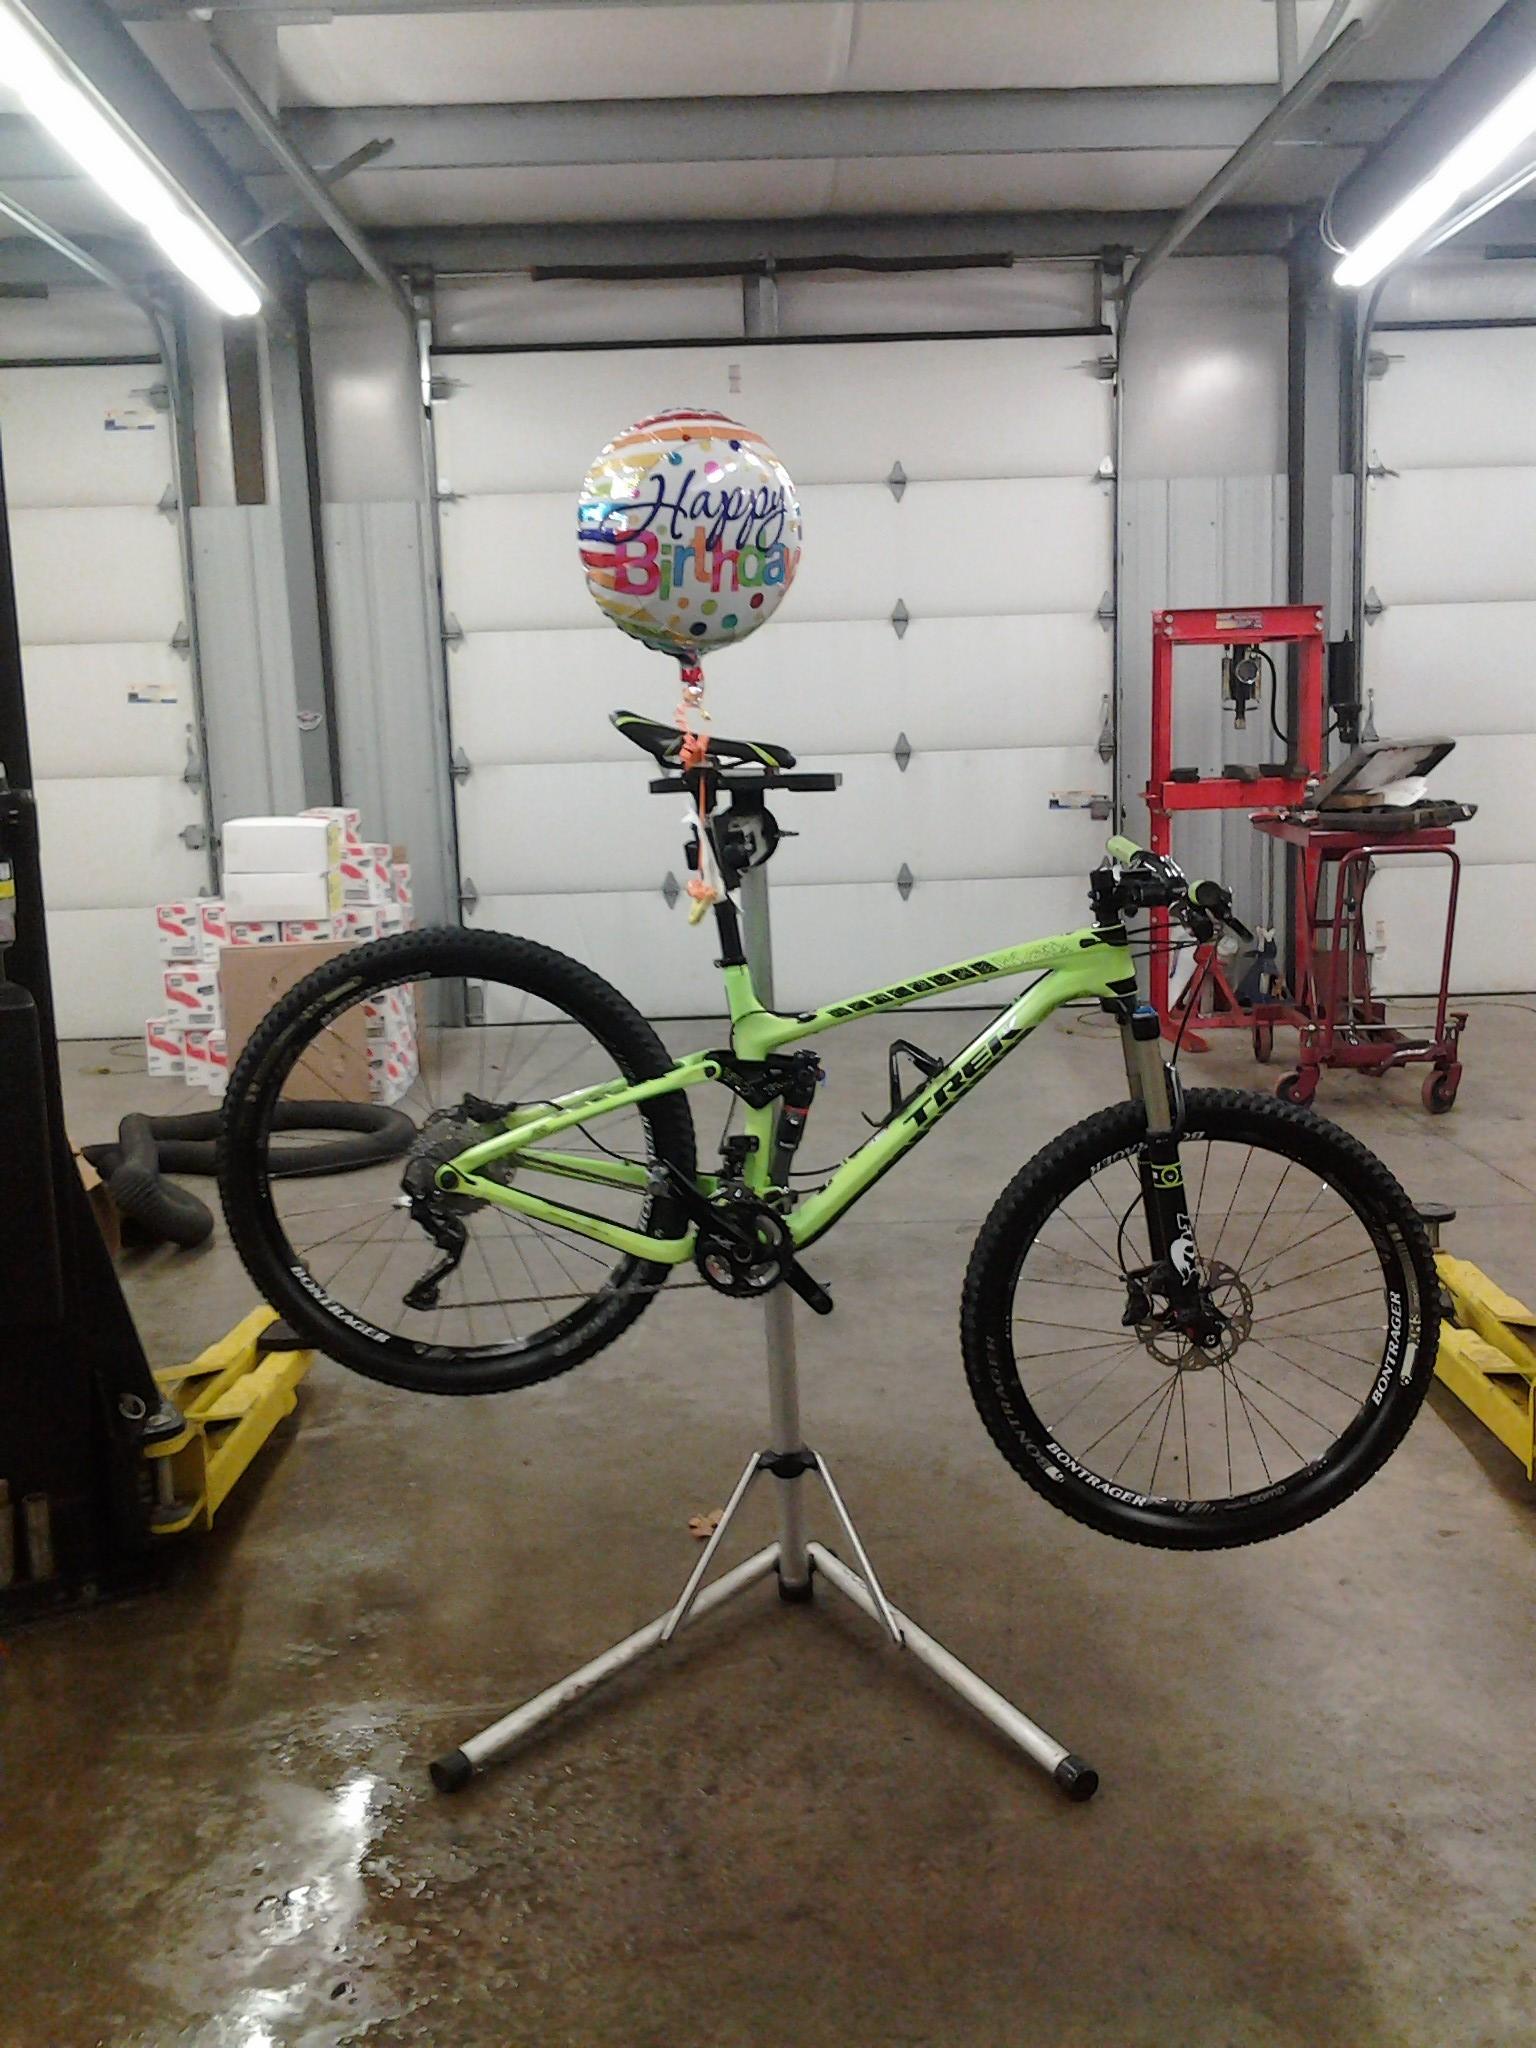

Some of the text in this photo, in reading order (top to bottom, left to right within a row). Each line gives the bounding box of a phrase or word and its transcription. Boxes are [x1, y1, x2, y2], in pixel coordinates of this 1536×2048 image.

[602, 469, 788, 552] Happy
[903, 1014, 1024, 1127] TREK
[1371, 1291, 1402, 1407] BONTRAGER
[1046, 1442, 1148, 1507] BONTRAGER
